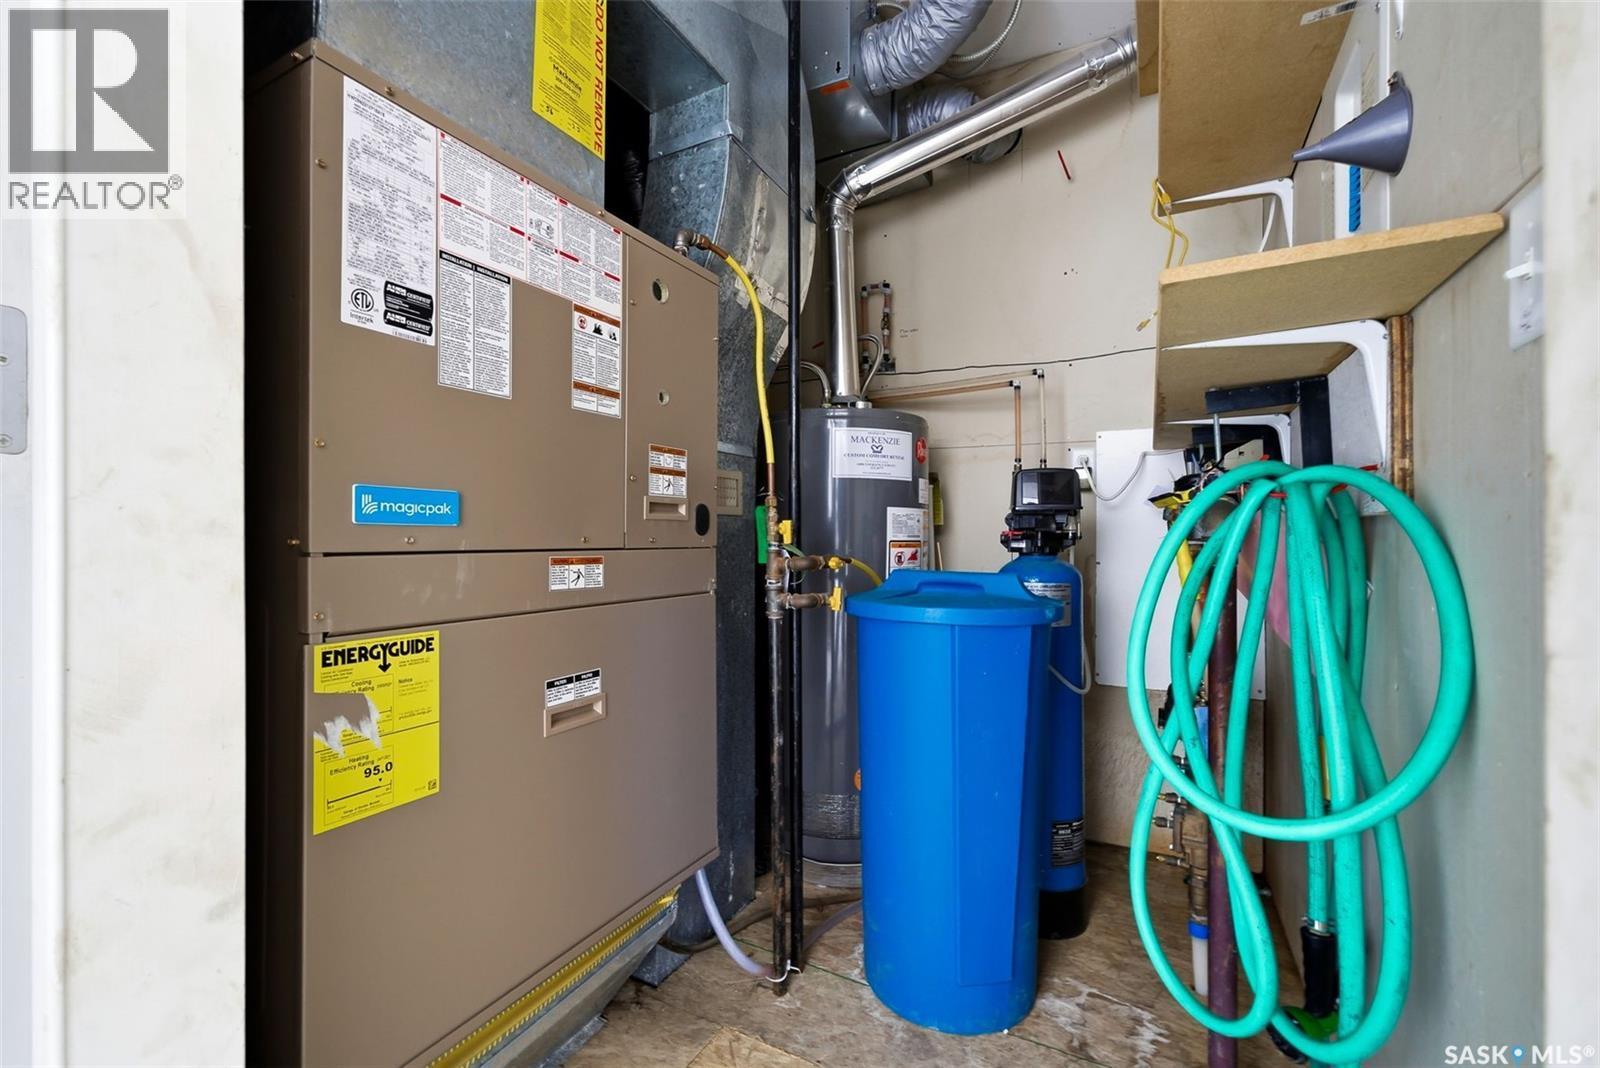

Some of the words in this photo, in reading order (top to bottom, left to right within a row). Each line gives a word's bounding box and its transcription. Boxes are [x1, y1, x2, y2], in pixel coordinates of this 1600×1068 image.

[594, 3, 604, 32] DO
[594, 35, 604, 76] NOT
[594, 76, 604, 155] REMOVE
[850, 436, 901, 445] MACKENZIE
[380, 502, 452, 516] magicpak
[320, 636, 435, 671] ENERGYGUIDE
[351, 679, 373, 688] Cooling
[329, 764, 357, 776] Efficiency
[357, 759, 375, 769] Rating
[348, 754, 370, 764] Heating
[363, 761, 393, 779] 95.0
